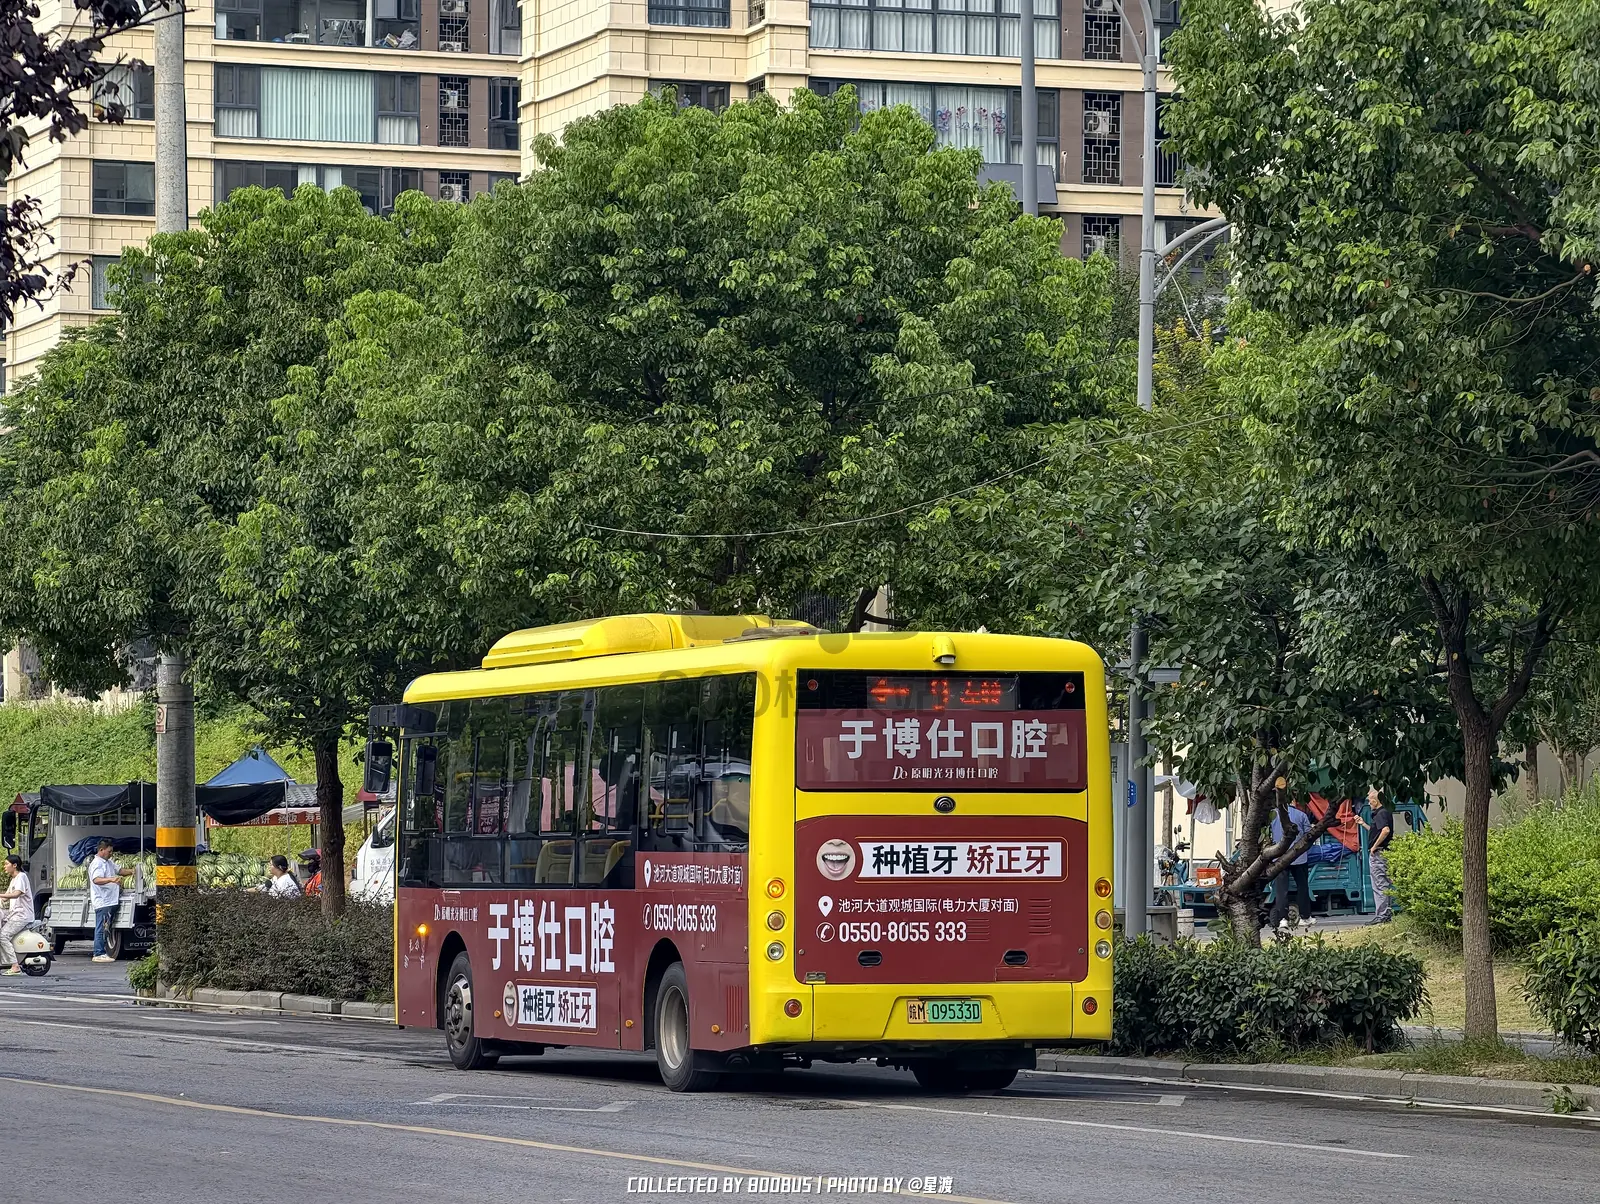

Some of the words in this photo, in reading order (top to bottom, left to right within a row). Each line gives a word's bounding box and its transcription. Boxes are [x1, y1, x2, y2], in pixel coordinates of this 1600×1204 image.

[839, 718, 1048, 760] 于博仕口腔
[872, 844, 958, 875] 种植牙
[966, 844, 1051, 875] 矫正牙
[653, 903, 698, 932] 0550-8055
[700, 904, 717, 932] 333
[838, 898, 1020, 914] 池河大道观城国际(电力大厦对面)
[487, 900, 616, 973] 于博仕口腔
[839, 921, 930, 942] 0550-8055
[934, 921, 967, 942] 333
[522, 988, 556, 1023] 种植牙
[558, 990, 592, 1026] 矫正牙
